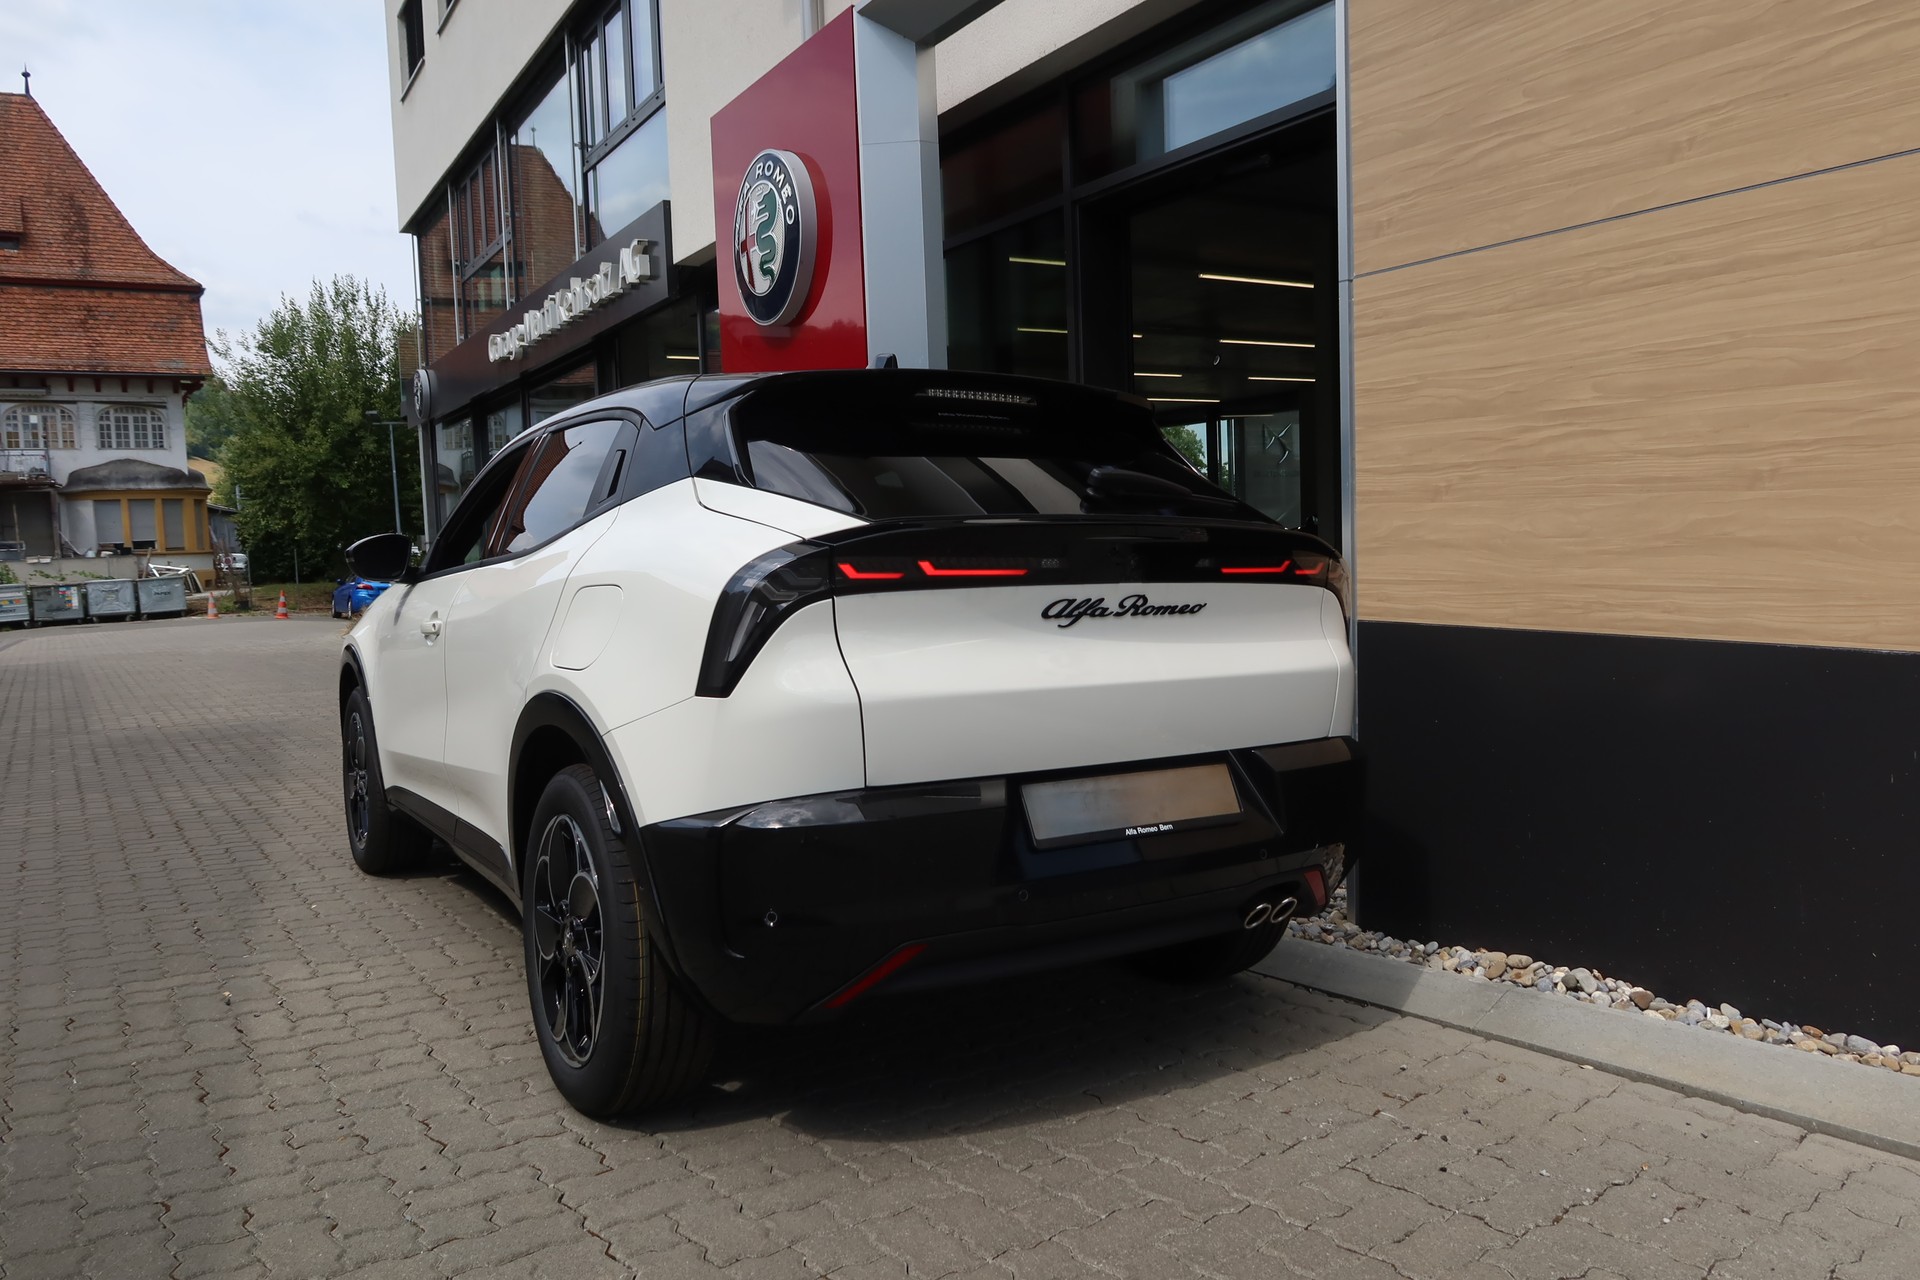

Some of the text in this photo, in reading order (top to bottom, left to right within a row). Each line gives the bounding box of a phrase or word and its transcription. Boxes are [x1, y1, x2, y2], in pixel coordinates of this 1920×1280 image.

[754, 160, 796, 226] ROMEO
[618, 238, 651, 289] AG
[1041, 594, 1207, 629] Alfa Romeo
[1137, 826, 1158, 834] Romeo
